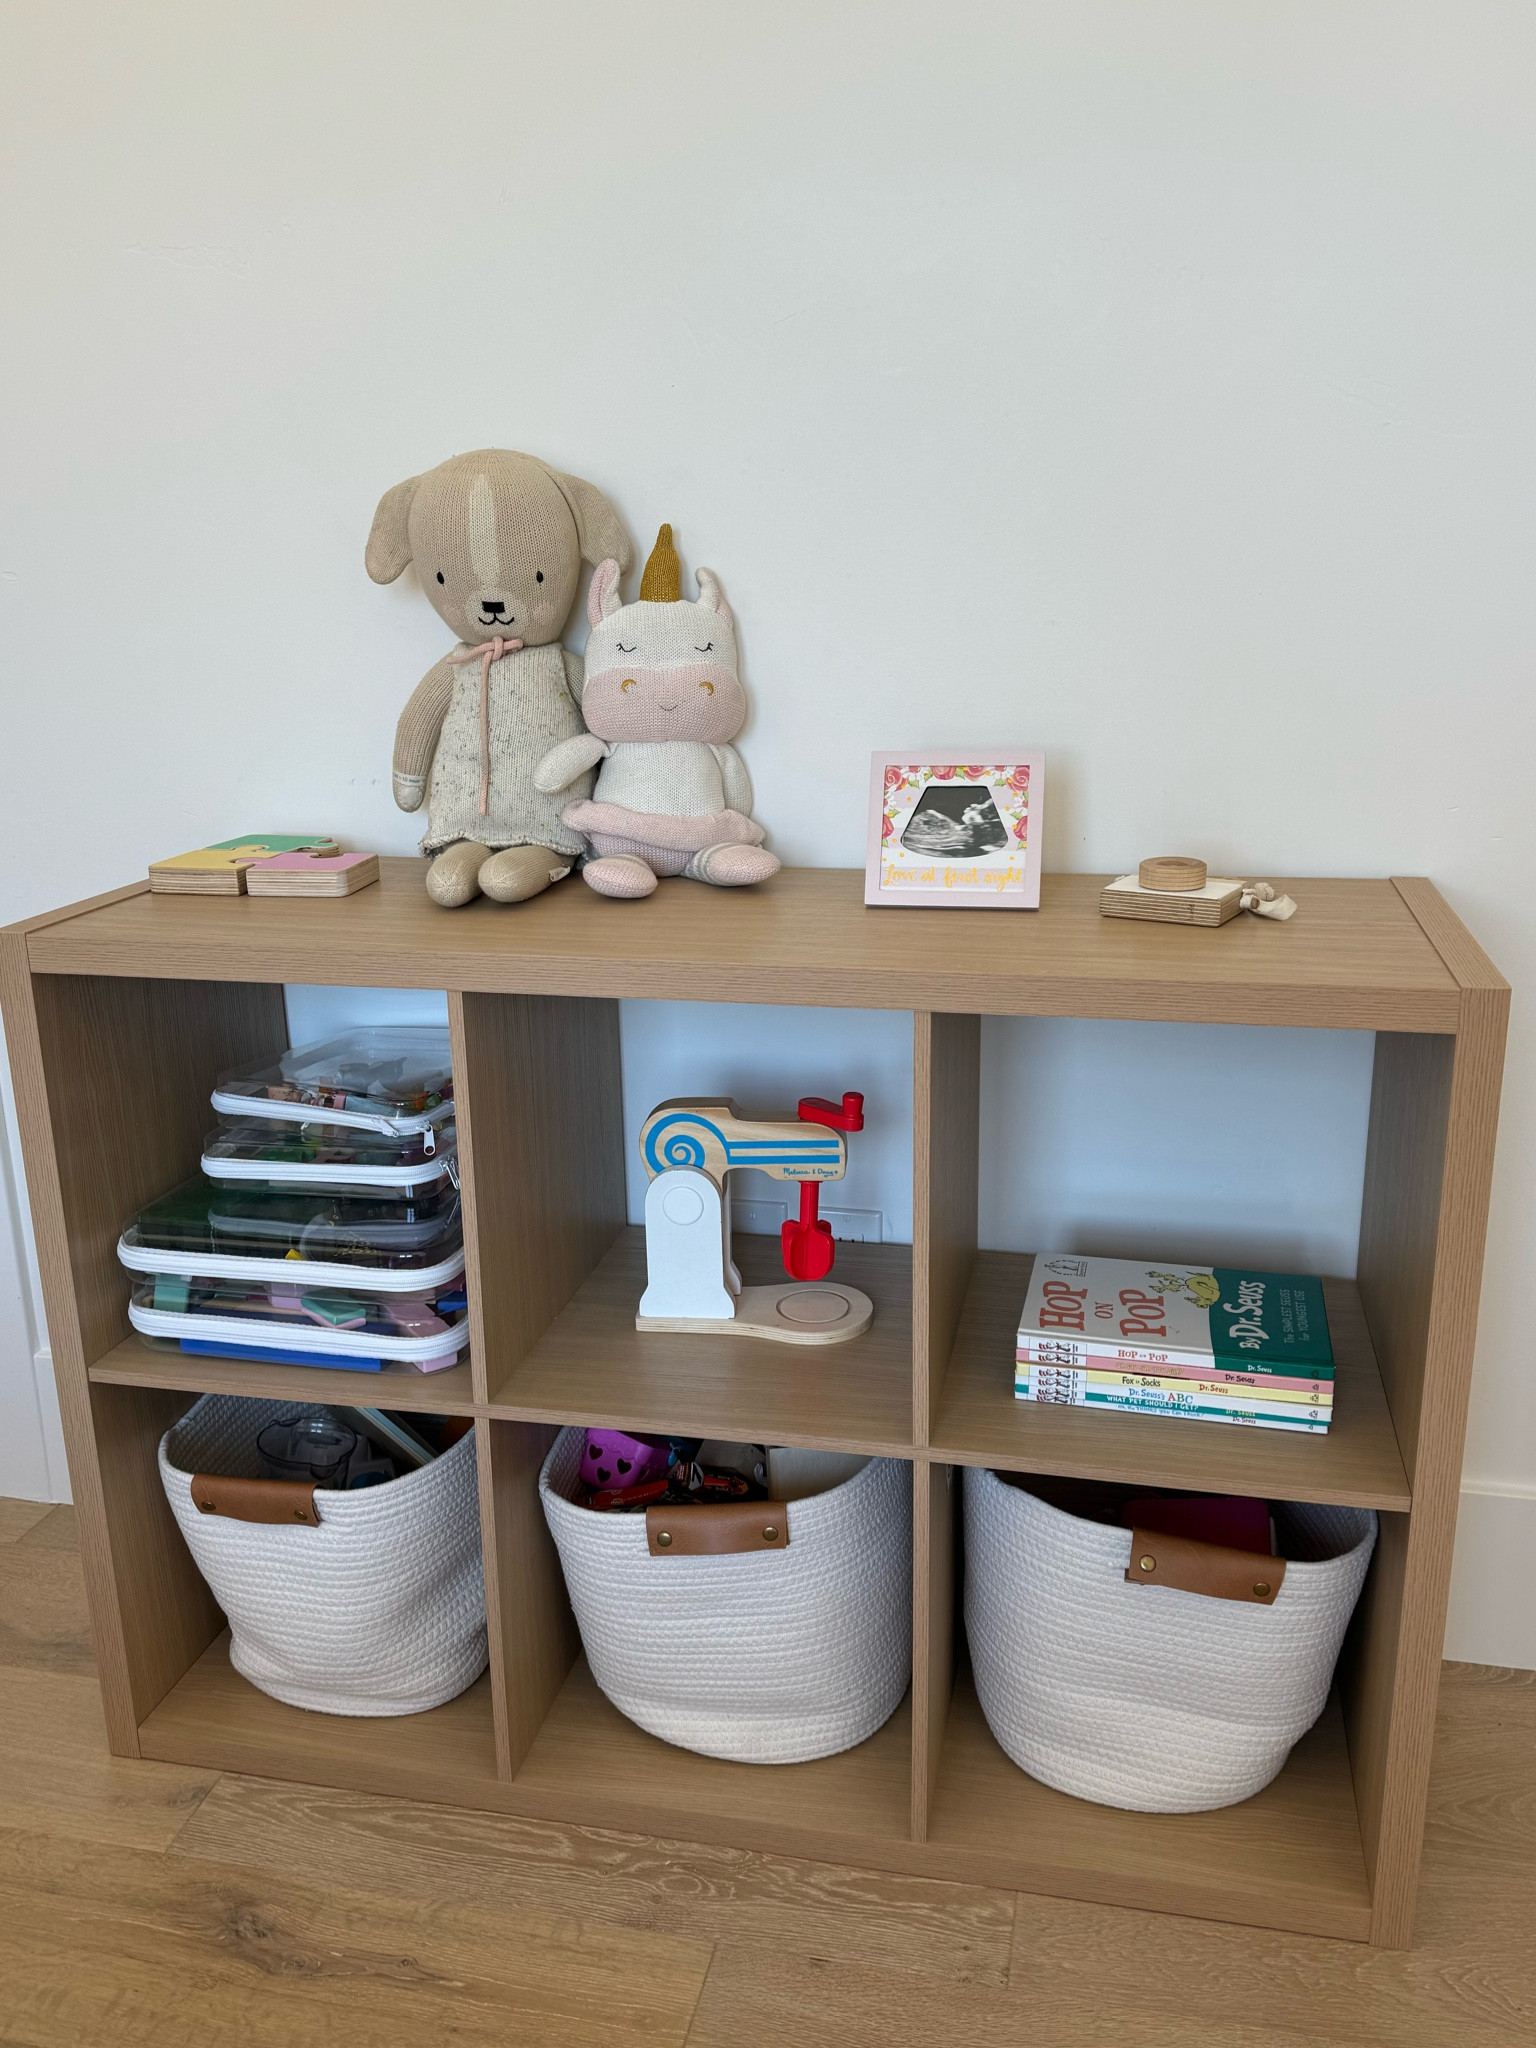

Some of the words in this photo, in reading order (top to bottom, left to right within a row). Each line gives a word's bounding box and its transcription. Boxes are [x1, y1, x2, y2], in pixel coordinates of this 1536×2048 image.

[883, 864, 918, 886] Love
[921, 866, 936, 882] at
[944, 866, 979, 888] first
[984, 866, 1022, 892] sight
[1223, 1280, 1266, 1316] Seuss
[1039, 1281, 1088, 1331] HOP
[1094, 1301, 1114, 1319] ON
[1118, 1289, 1167, 1337] POP
[1229, 1317, 1270, 1340] Dr.
[1239, 1337, 1262, 1350] By
[1118, 1350, 1138, 1358] HOP
[1149, 1353, 1168, 1362] POP
[1248, 1364, 1257, 1372] Dr.
[1257, 1365, 1272, 1373] Seuss
[1122, 1376, 1134, 1384] Fox
[1141, 1378, 1160, 1387] Socks
[1236, 1375, 1255, 1384] Seuss
[1128, 1388, 1140, 1396] Dr.
[1168, 1392, 1193, 1404] ABC
[1210, 1384, 1228, 1394] Seuss
[1107, 1395, 1126, 1403] WHAT
[1145, 1400, 1173, 1408] SHOULD
